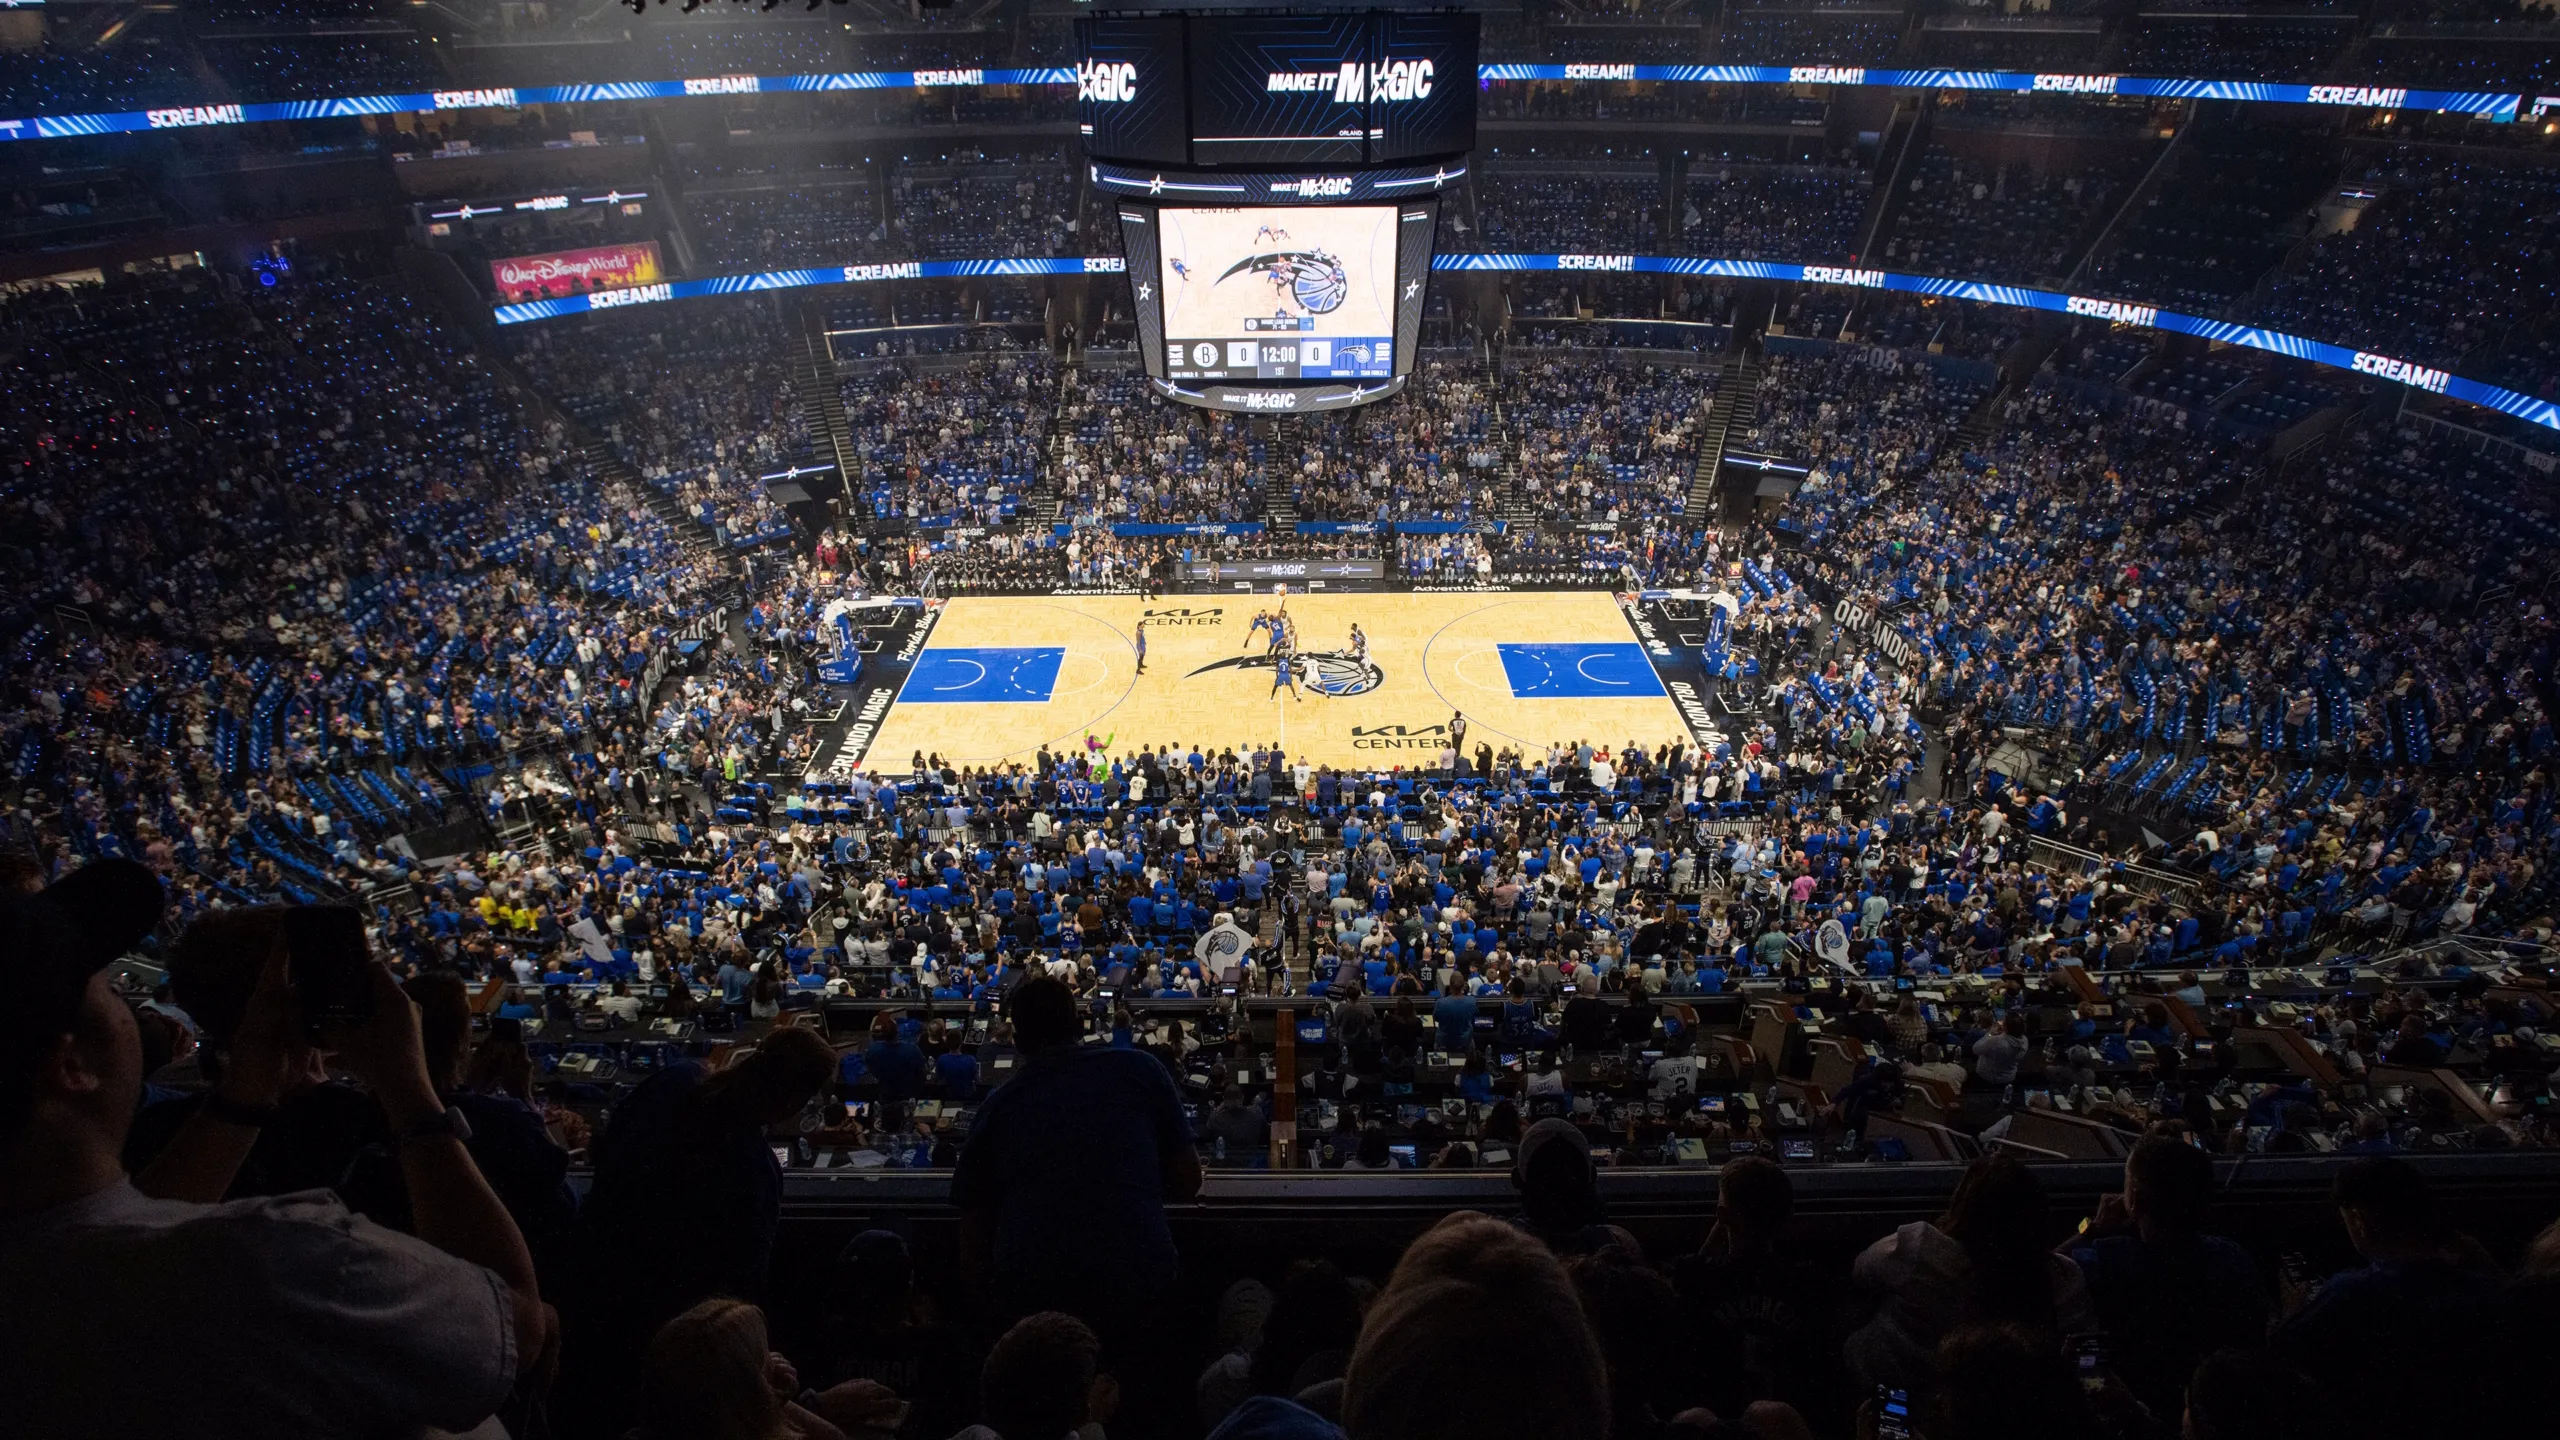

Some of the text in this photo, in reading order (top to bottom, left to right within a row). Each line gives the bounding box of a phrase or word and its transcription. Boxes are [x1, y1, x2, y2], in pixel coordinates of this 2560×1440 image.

[914, 69, 981, 86] SCREAM!!
[1077, 57, 1136, 103] AGIC
[1267, 57, 1433, 104] MAKE IT MAGIC
[1564, 64, 1634, 80] SCREAM!!
[1789, 67, 1864, 85] SCREAM!!
[684, 79, 759, 95] SCREAM!!
[2032, 74, 2117, 94] SCREAM!!
[433, 88, 517, 109] SCREAM!!
[2307, 86, 2405, 108] SCREAM!!
[147, 104, 246, 129] SCREAM!!
[1271, 176, 1352, 198] MAKE IT MAGIC
[531, 259, 591, 279] Disney
[588, 255, 628, 271] World
[844, 262, 922, 281] SCREAM!!
[1557, 254, 1633, 271] SCREAM!!
[1802, 265, 1885, 287] SCREAM!!
[588, 283, 673, 309] SCREAM!!
[2066, 296, 2158, 327] SCREAM!!
[1168, 345, 1184, 366] BKN
[1240, 348, 1247, 362] 0
[1262, 346, 1296, 362] 12:00
[1313, 347, 1319, 361] 0
[1375, 343, 1390, 363] ORL
[1275, 367, 1285, 375] 1ST
[2350, 351, 2450, 394] SCREAM!!
[1247, 392, 1295, 409] MAGIC
[1200, 525, 1227, 534] MAGIC
[1590, 523, 1618, 532] MAGIC
[1271, 564, 1306, 576] MAGIC
[1143, 618, 1222, 626] CENTER
[896, 629, 925, 662] Florida
[859, 687, 893, 721] MAGIC
[1670, 681, 1714, 729] ORLANDO
[1327, 968, 1333, 977] 5
[1421, 972, 1432, 980] 50
[1668, 1066, 1691, 1077] JETER
[1676, 1077, 1688, 1095] 2
